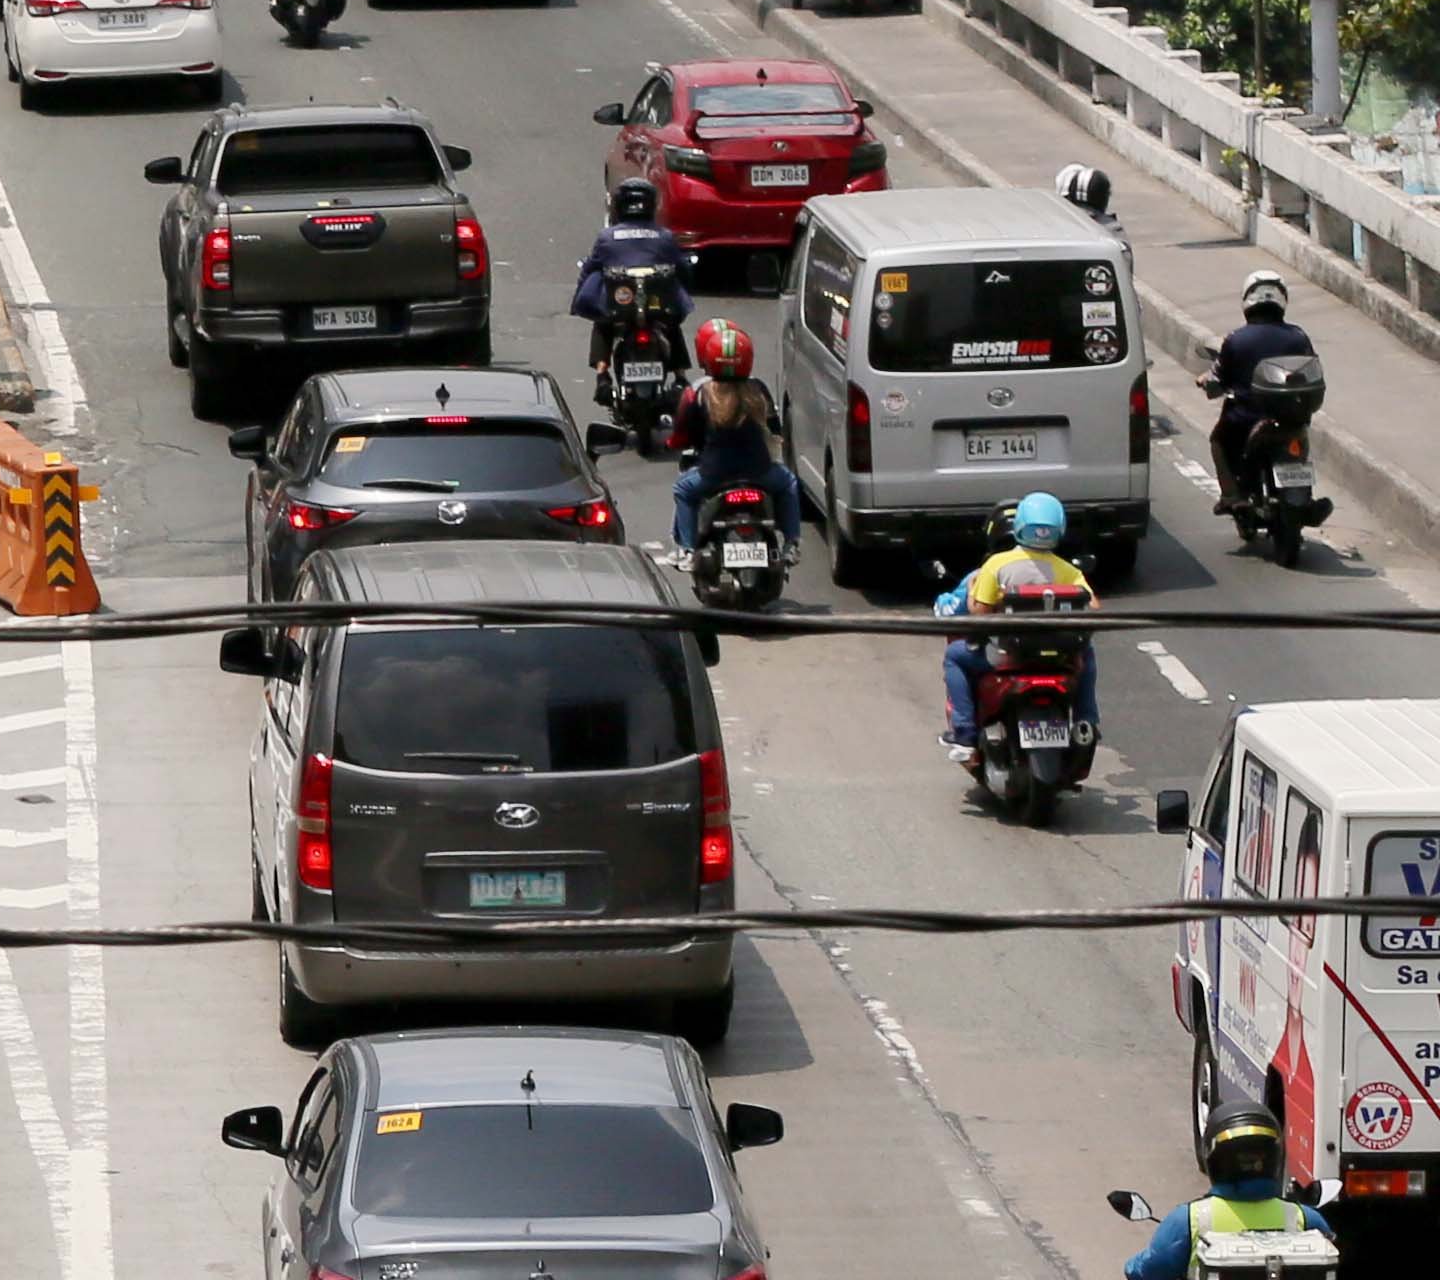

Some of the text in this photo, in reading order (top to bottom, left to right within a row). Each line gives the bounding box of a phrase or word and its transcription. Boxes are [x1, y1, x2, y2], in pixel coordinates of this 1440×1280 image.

[315, 309, 377, 325] NFA 5036
[967, 439, 1035, 456] EAF 1444
[1397, 965, 1429, 985] Sa
[1356, 1083, 1403, 1101] SENATOR
